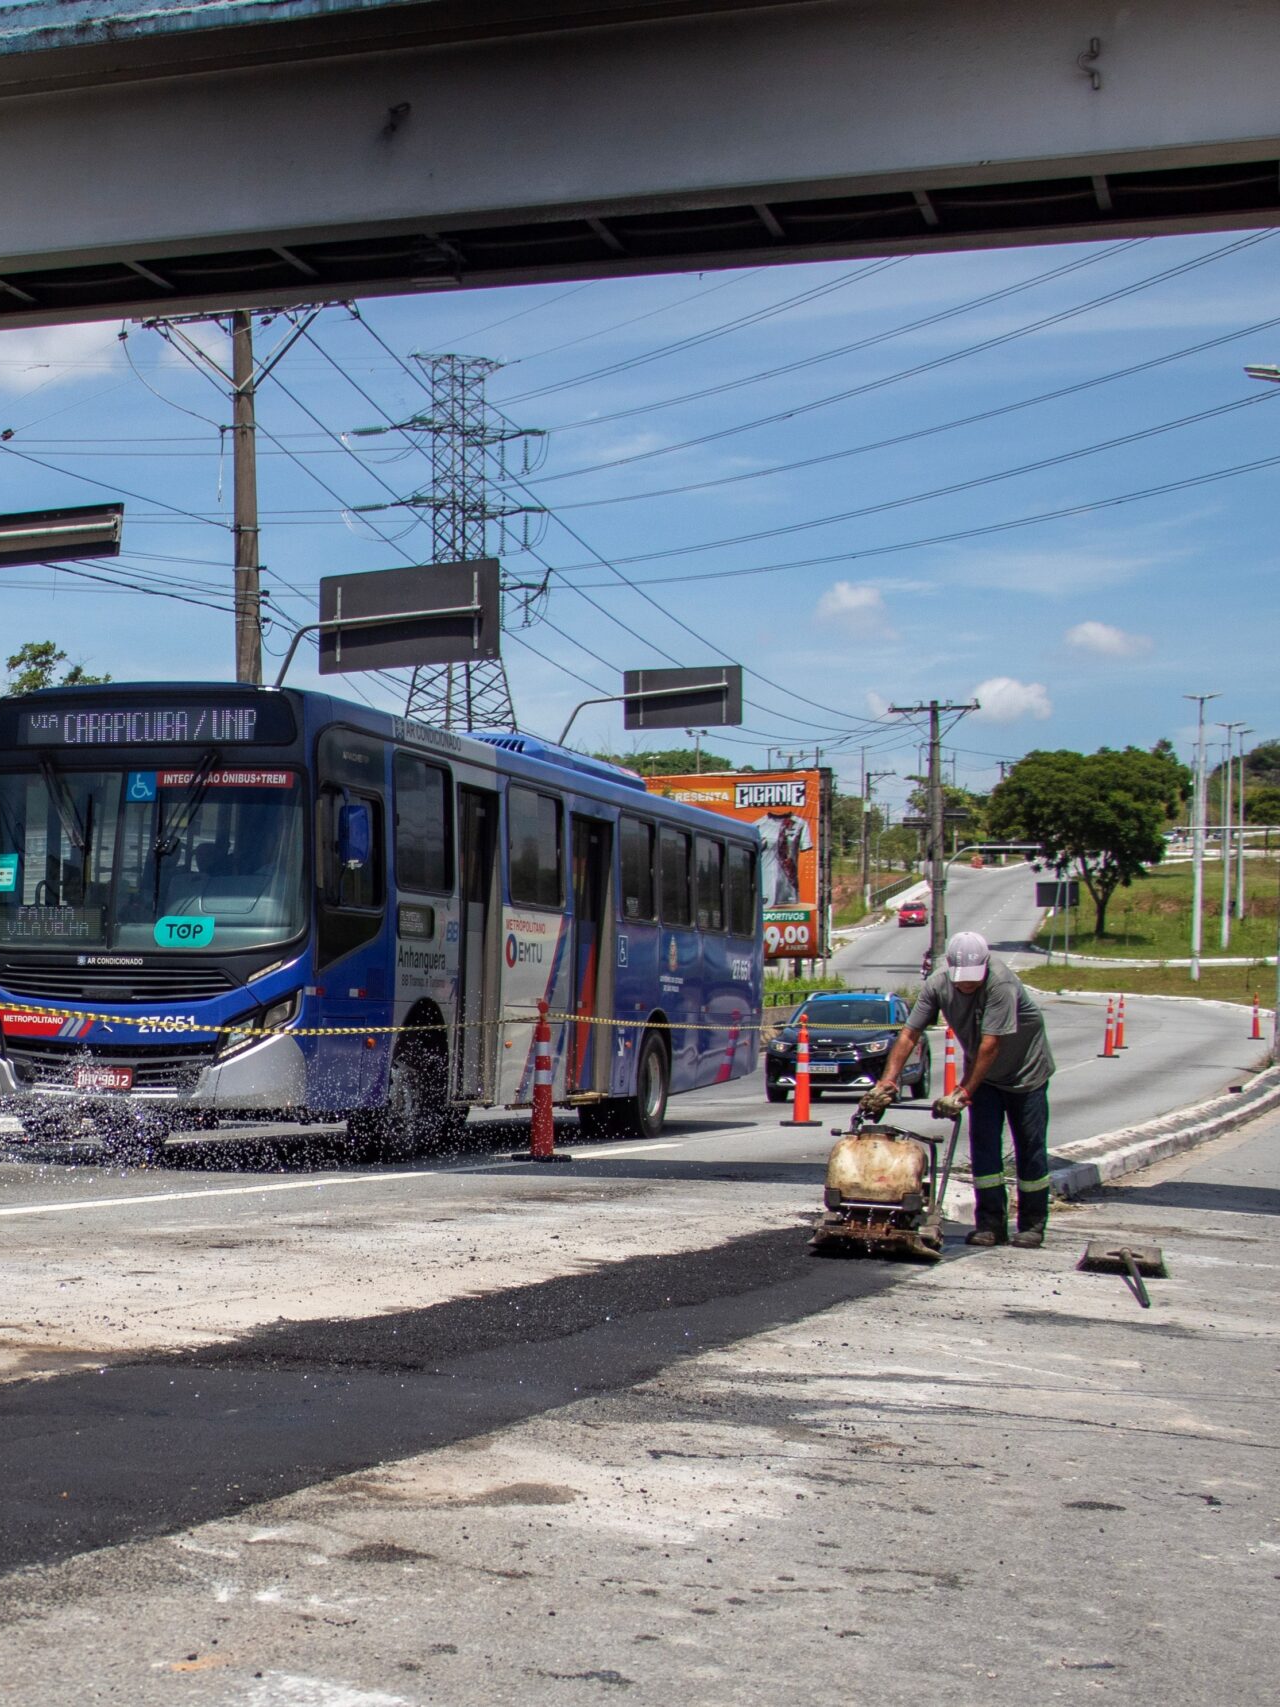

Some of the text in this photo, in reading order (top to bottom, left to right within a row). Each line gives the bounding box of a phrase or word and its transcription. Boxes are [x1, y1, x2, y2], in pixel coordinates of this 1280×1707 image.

[31, 714, 58, 728] VIA
[64, 711, 188, 743] CARAPICUIBA
[212, 709, 257, 740] UNIP
[163, 771, 286, 785] INTEGAÃO ÔNIBUS+TREM
[735, 782, 805, 808] GIGANTE
[18, 906, 75, 920] FATIMA
[7, 921, 89, 936] VILA VELHA
[166, 923, 203, 939] TOP
[763, 926, 809, 953] 9,00
[398, 945, 446, 974] Anhanguera
[519, 942, 543, 963] EMTU
[87, 957, 143, 966] AR CONDICIONADO
[3, 1015, 64, 1025] METROPOLITANO
[138, 1015, 195, 1033] 27.651
